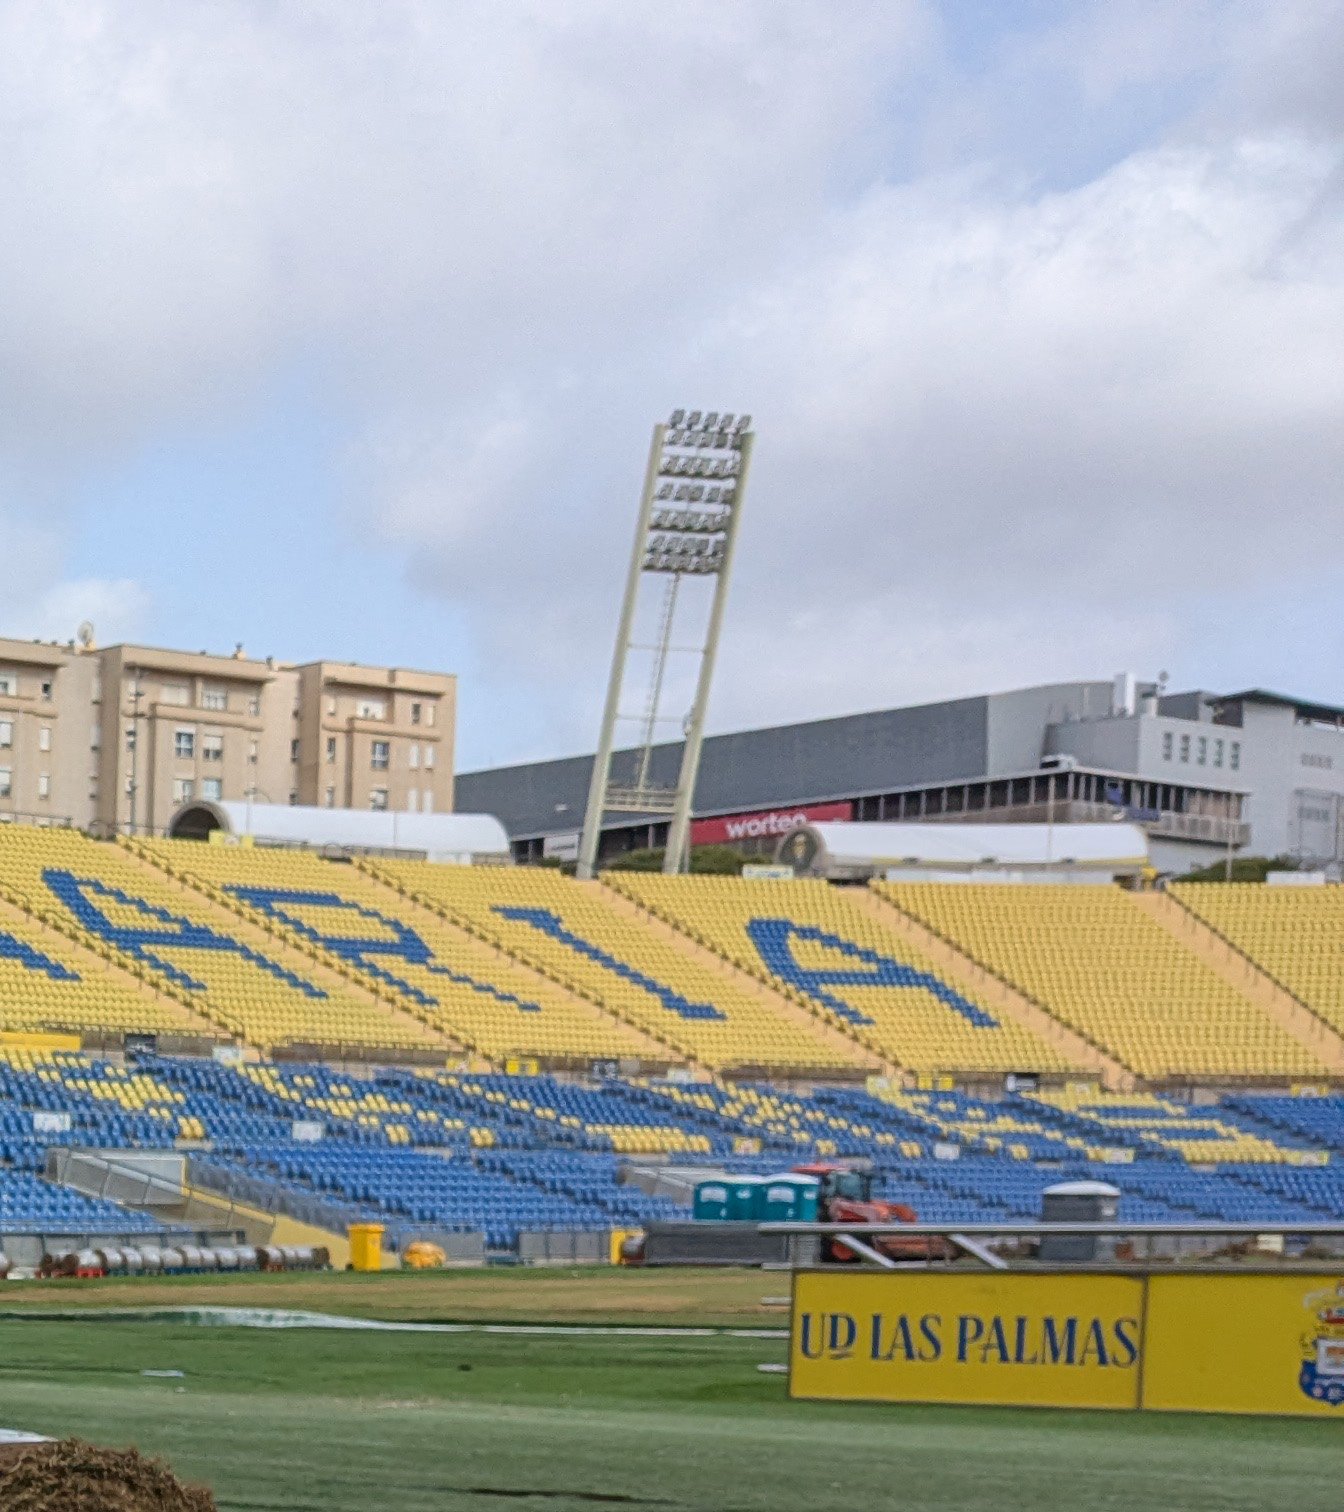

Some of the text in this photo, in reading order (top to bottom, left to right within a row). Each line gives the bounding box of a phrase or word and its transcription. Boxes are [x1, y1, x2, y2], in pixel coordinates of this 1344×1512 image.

[800, 1311, 1139, 1370] UD LAS PALMAS
